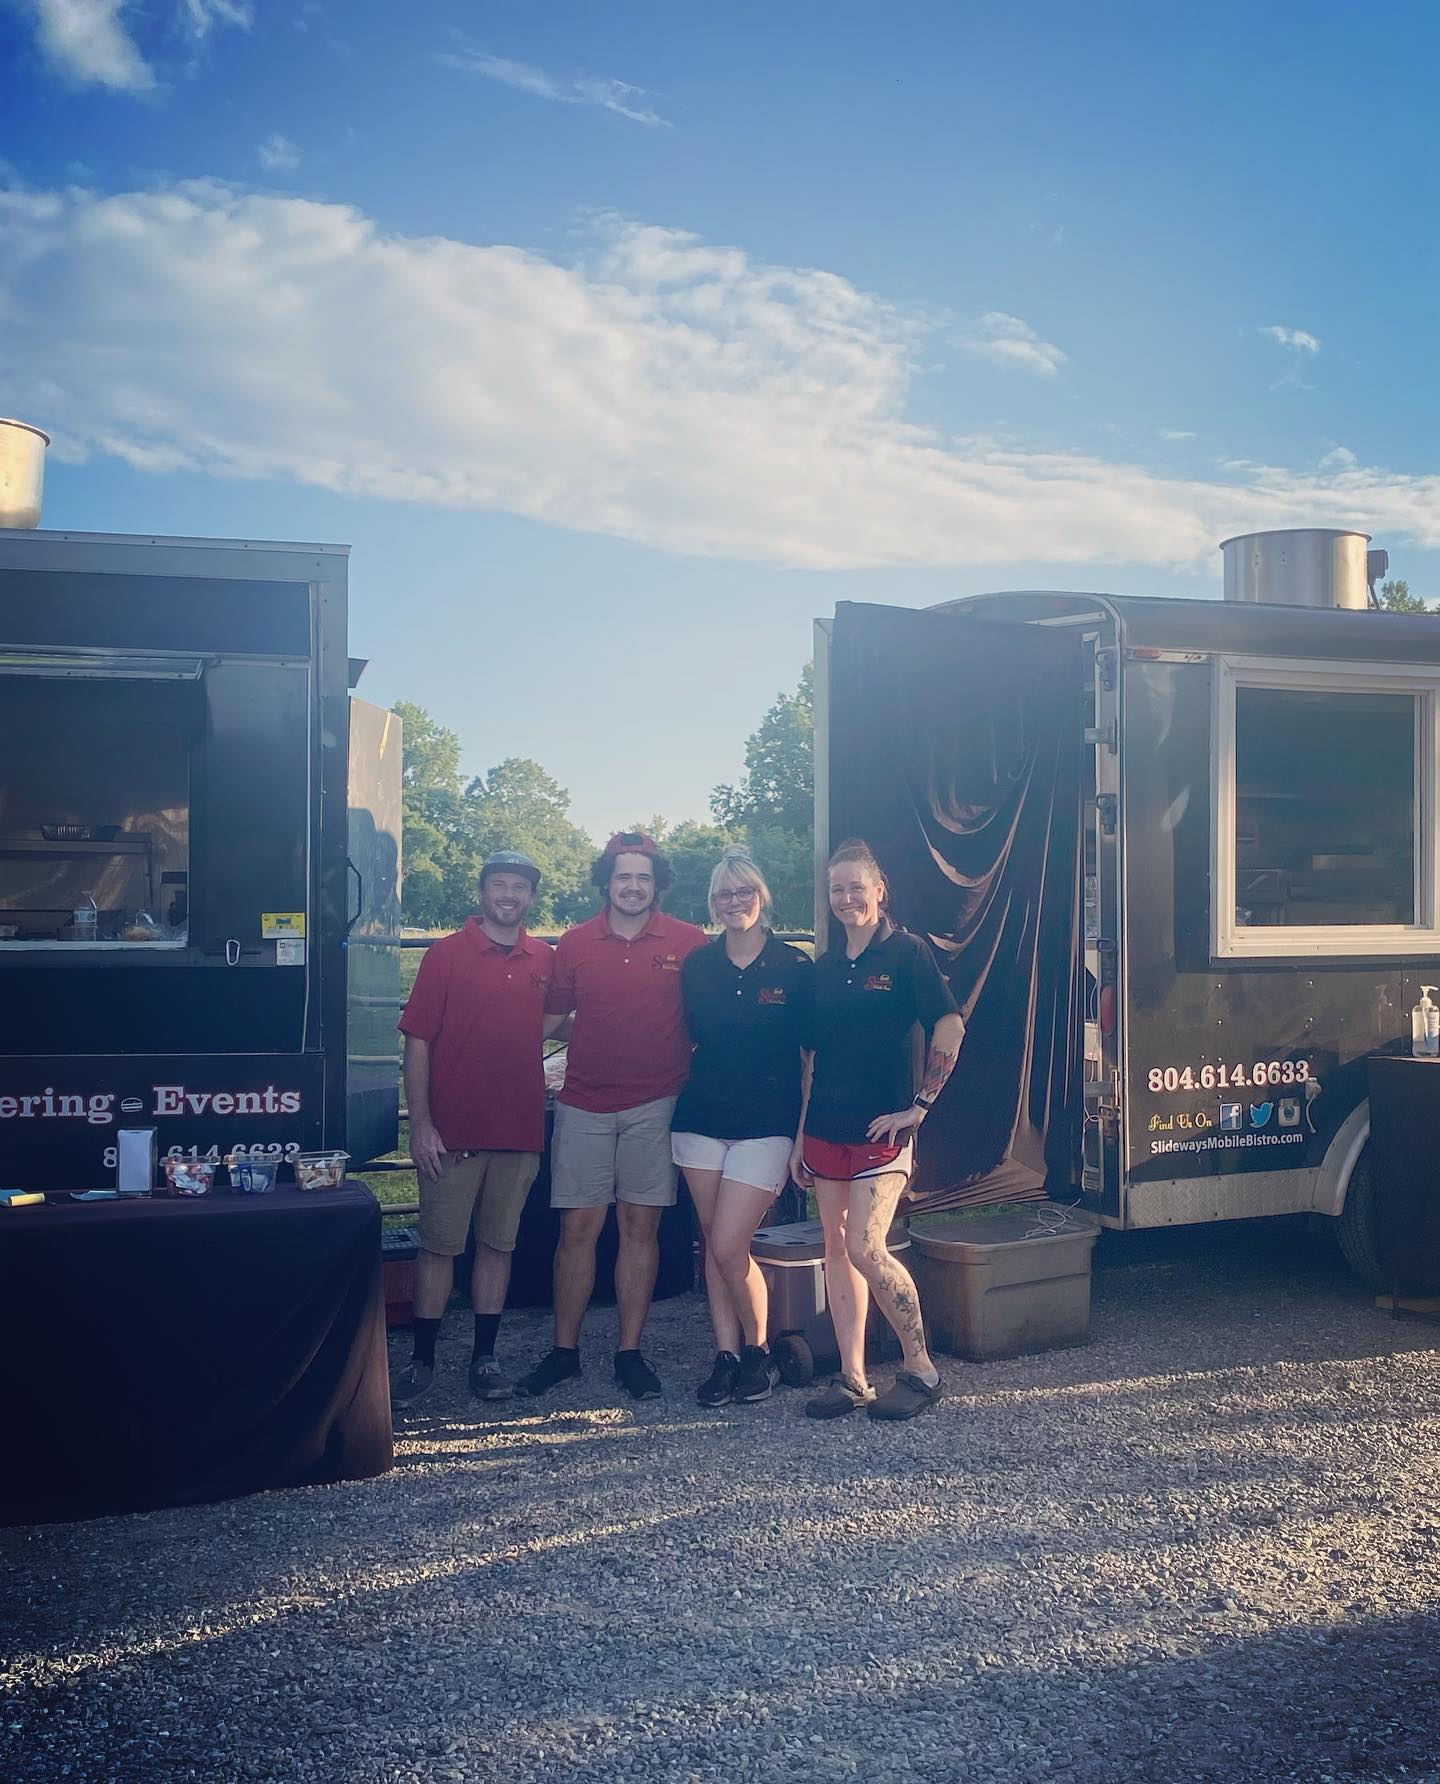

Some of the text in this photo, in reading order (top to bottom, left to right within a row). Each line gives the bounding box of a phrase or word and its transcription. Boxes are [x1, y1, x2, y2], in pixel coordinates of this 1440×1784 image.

[1148, 1060, 1309, 1092] 804.614.6633
[152, 1085, 301, 1115] Events
[1148, 1113, 1174, 1132] Find
[1176, 1113, 1193, 1129] Us
[1195, 1112, 1213, 1128] On
[1150, 1133, 1304, 1154] SlidewaysMobileBistro.com
